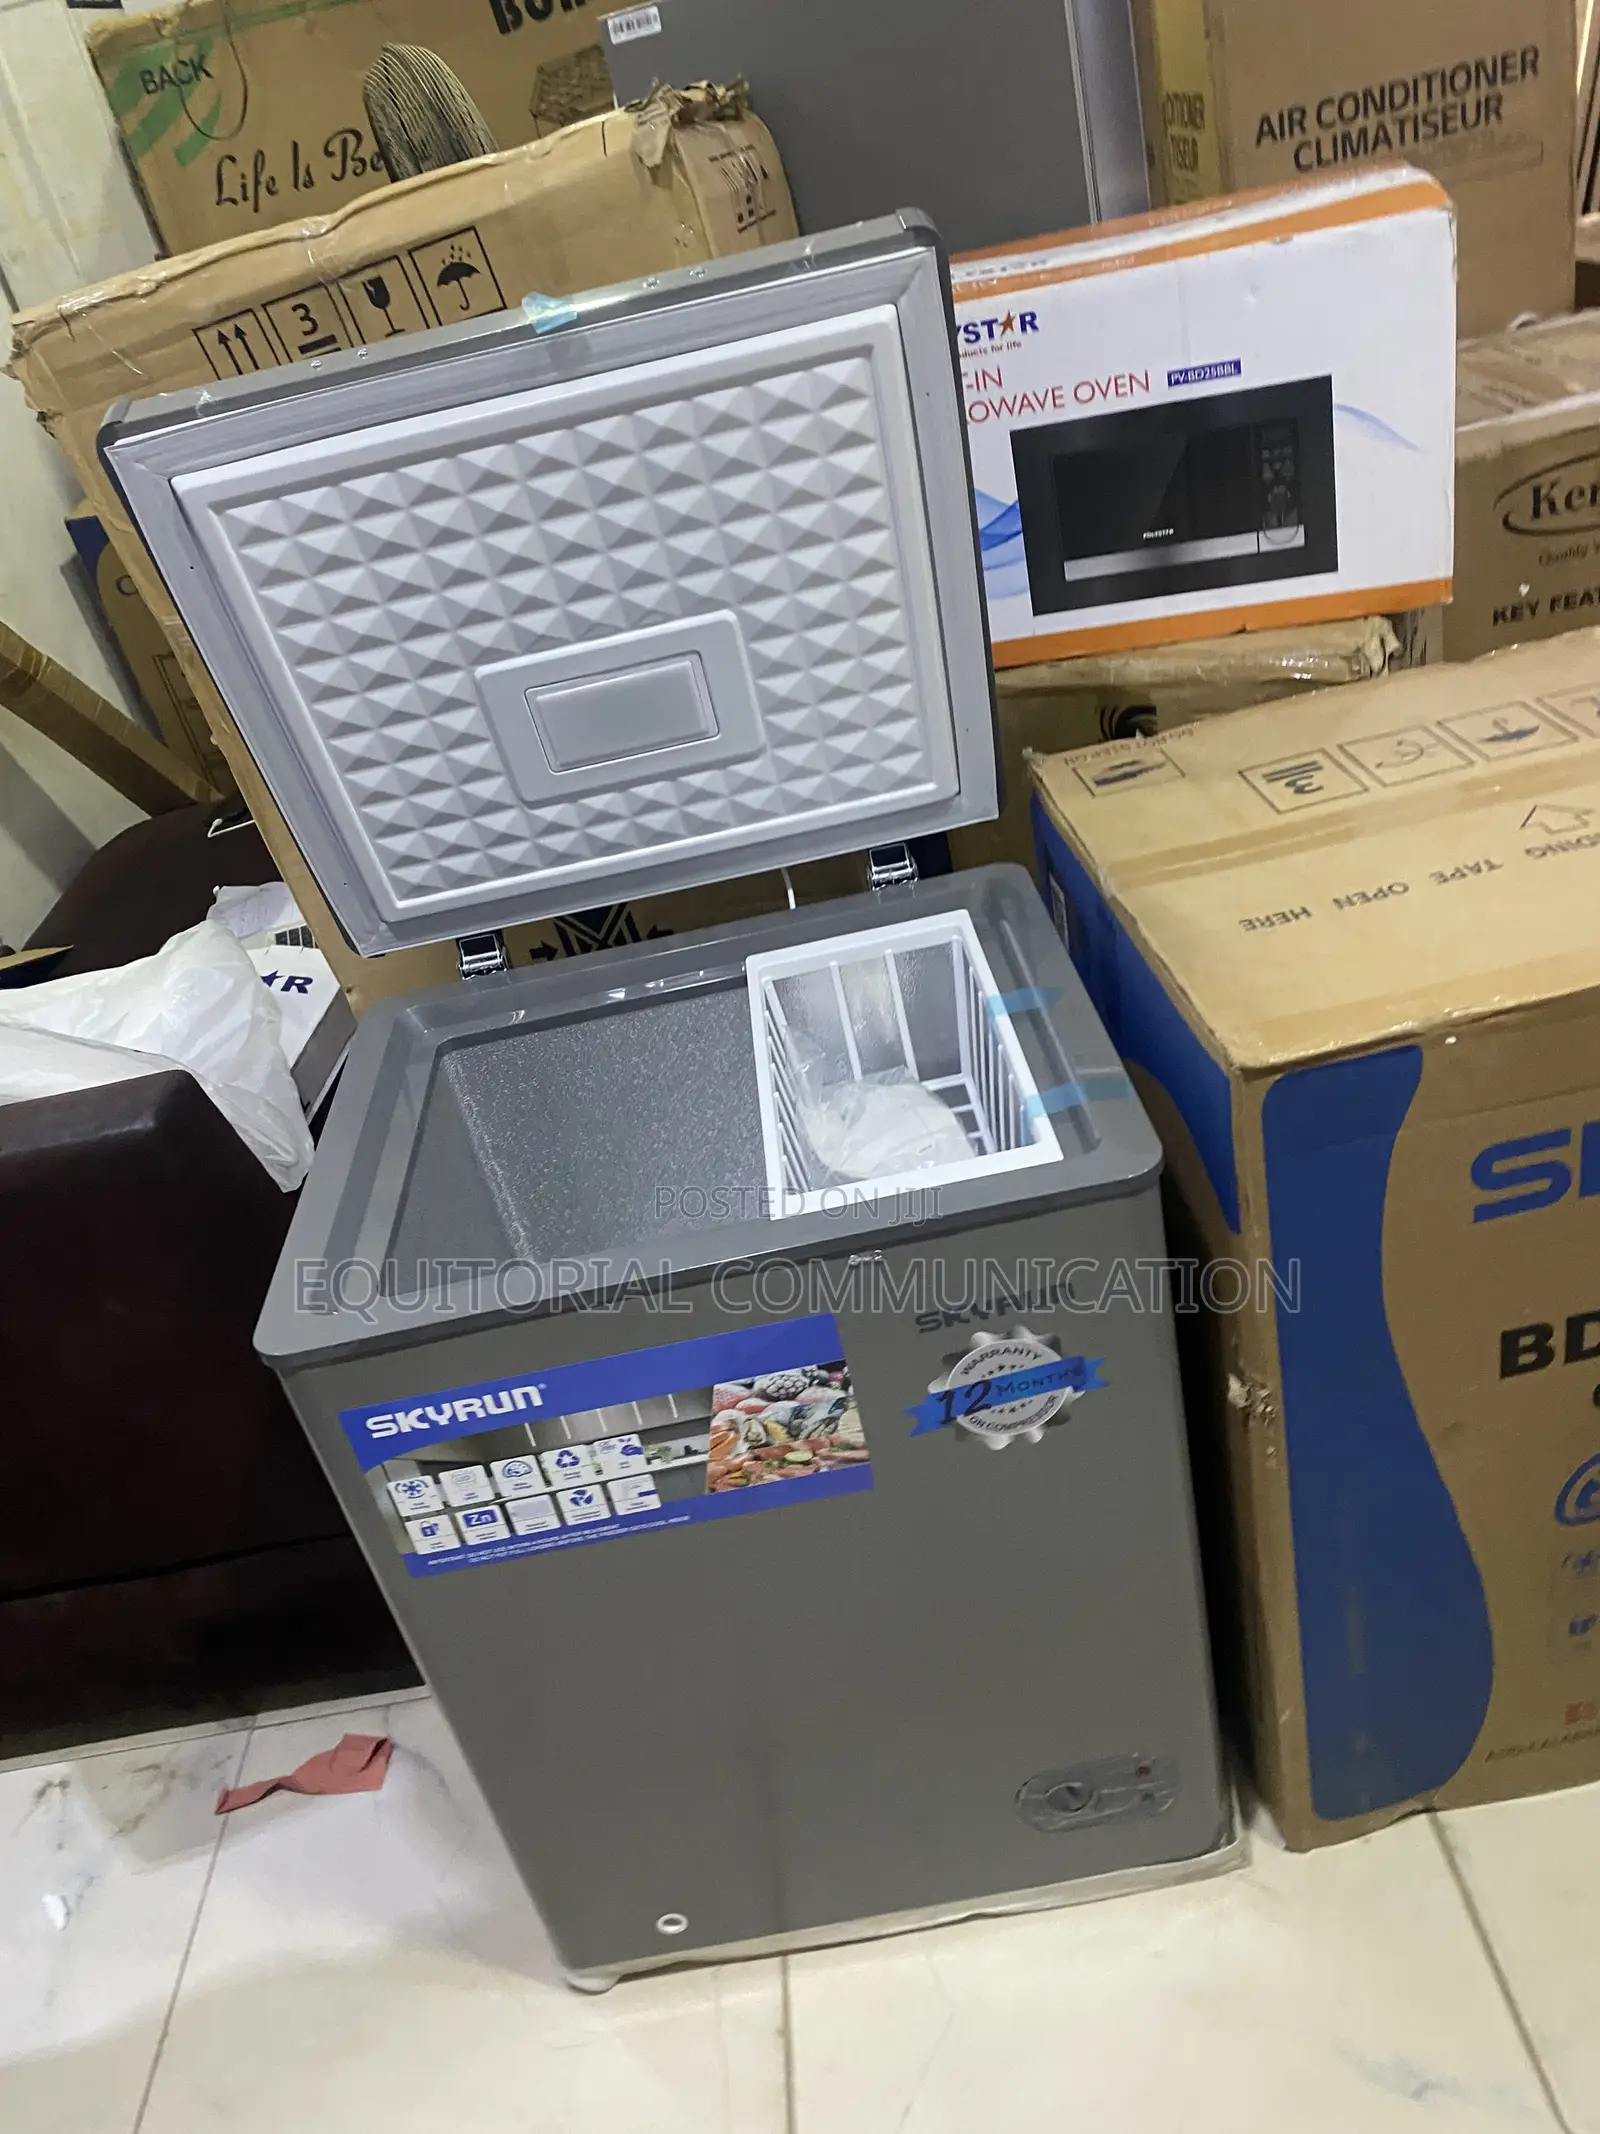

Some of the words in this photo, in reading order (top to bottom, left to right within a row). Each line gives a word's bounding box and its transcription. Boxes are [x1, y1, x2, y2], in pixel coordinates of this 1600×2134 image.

[139, 55, 214, 95] BACK
[1256, 104, 1308, 149] AIR
[1315, 45, 1541, 131] CONDITIONER
[1293, 92, 1504, 172] CLIMATISEUR
[215, 148, 279, 214] Life
[290, 139, 316, 191] Is
[291, 302, 319, 336] 3
[990, 343, 1003, 353] for
[1006, 340, 1022, 351] life
[1073, 369, 1150, 405] OVEN
[1492, 598, 1540, 627] KEY
[1429, 858, 1504, 886] TAPE
[1331, 881, 1410, 911] OPEN
[1237, 905, 1313, 932] HERE
[960, 1346, 1043, 1376] WARRANTY
[366, 1385, 543, 1439] SKYRUN
[936, 1378, 993, 1425] 12
[467, 1511, 493, 1526] Zn
